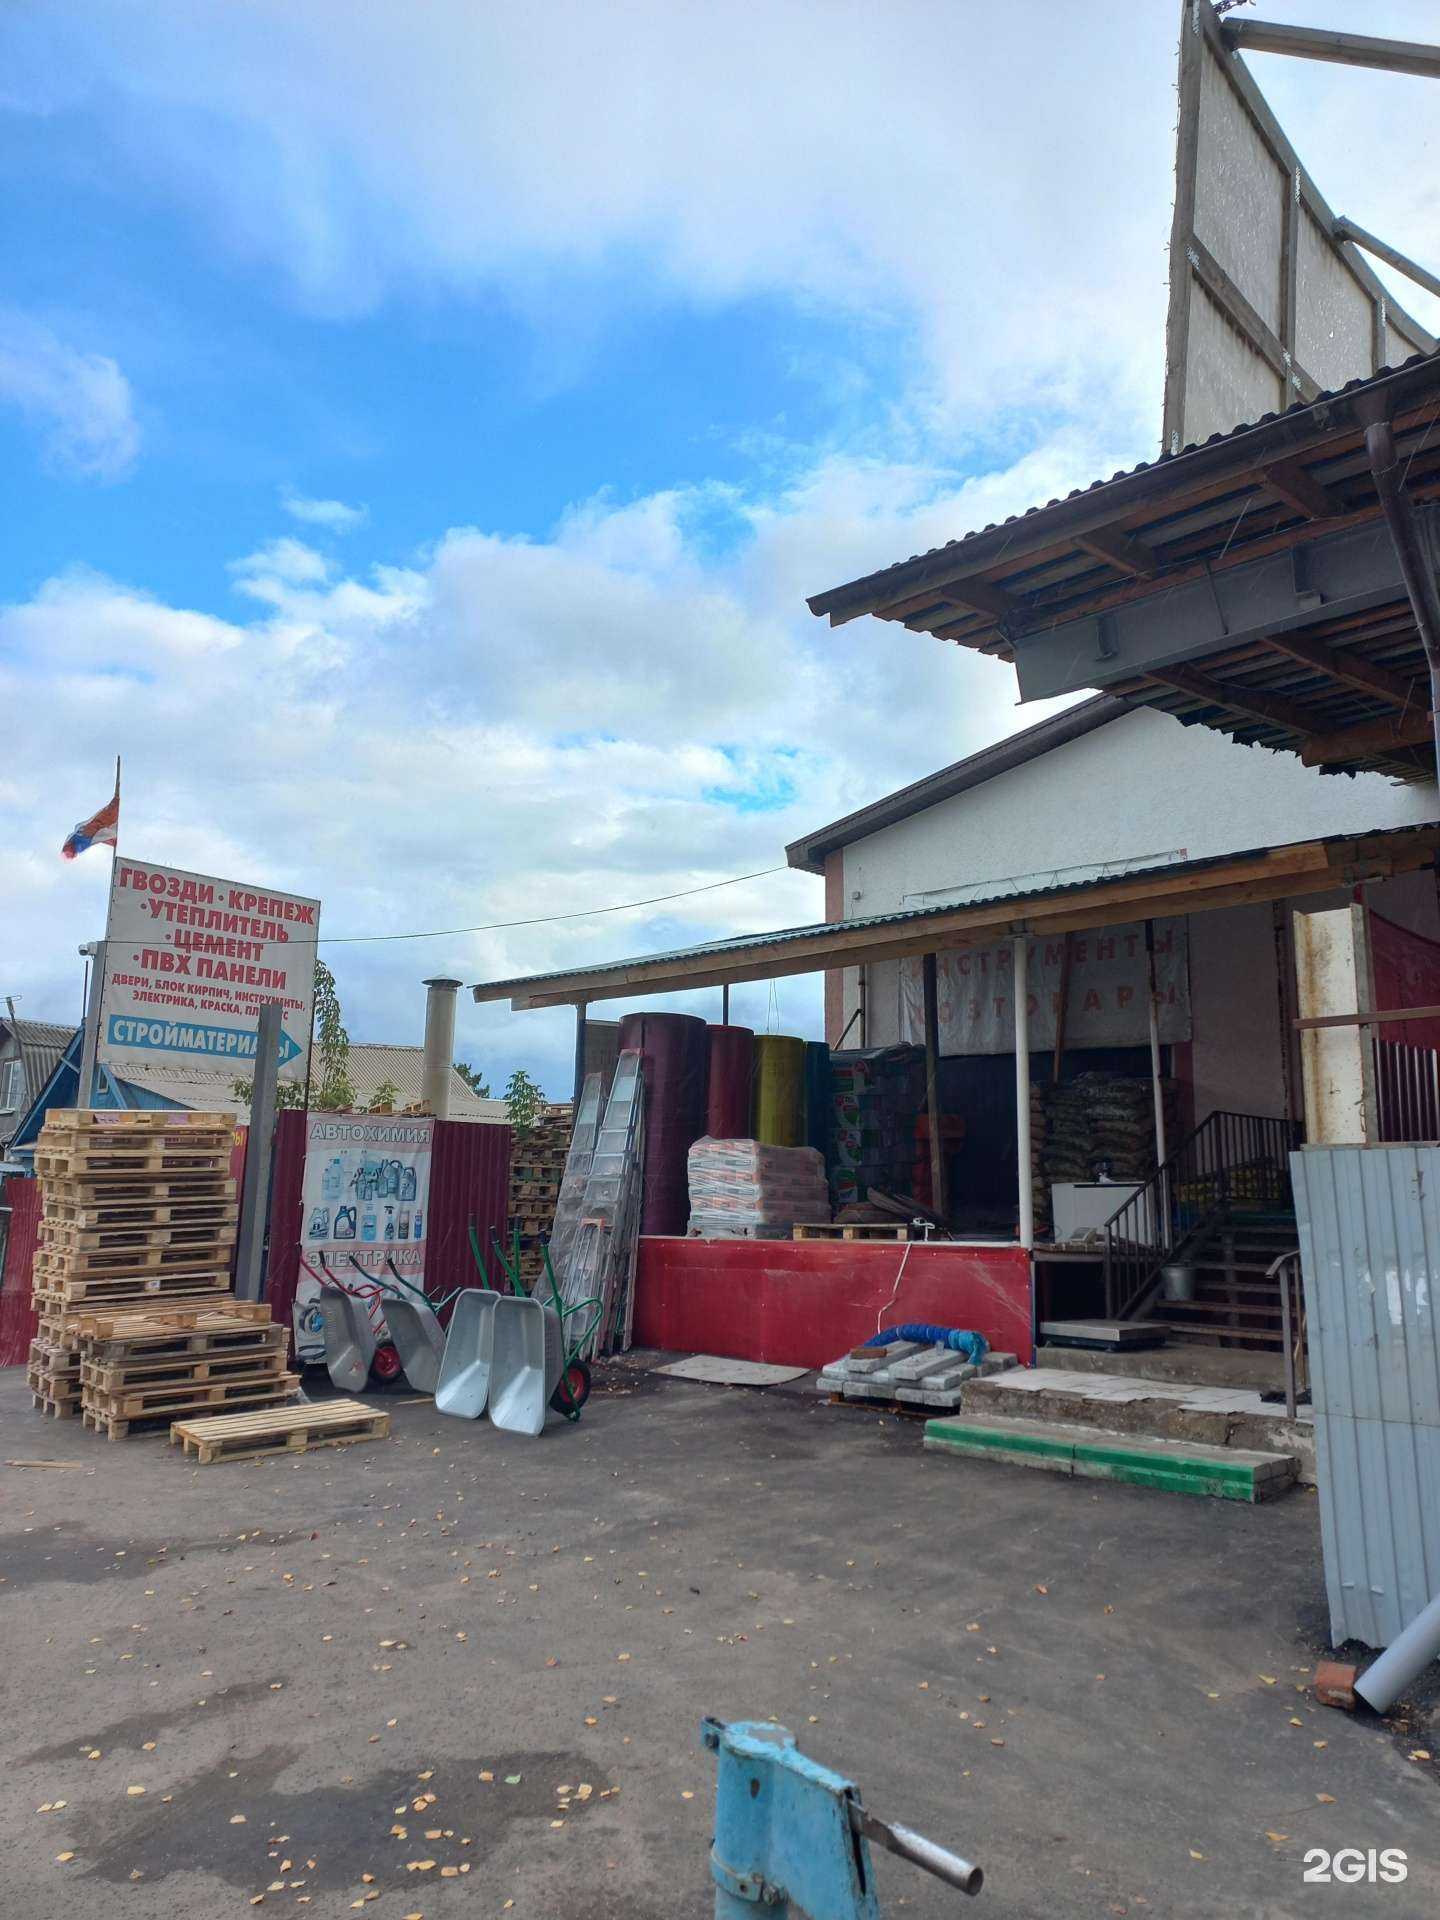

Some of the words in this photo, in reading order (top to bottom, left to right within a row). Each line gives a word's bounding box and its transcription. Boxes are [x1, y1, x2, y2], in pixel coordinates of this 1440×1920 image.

[119, 868, 214, 904] ГВОЗДИ
[228, 890, 314, 925] КРЕПЕЖ
[148, 898, 289, 943] УТЕПЛИТЕЛЬ
[174, 929, 264, 961] ЦЕМЕНТ
[141, 949, 191, 975] ПВХ
[196, 958, 287, 990] ПАНЕЛИ
[111, 973, 152, 989] ДВЕРИ,
[155, 980, 185, 993] БЛОК
[187, 984, 233, 1001] КИРПИЧ,
[132, 990, 198, 1010] ЭЛЕКТРИКА,
[310, 1123, 431, 1144] АВТОХИМИЯ
